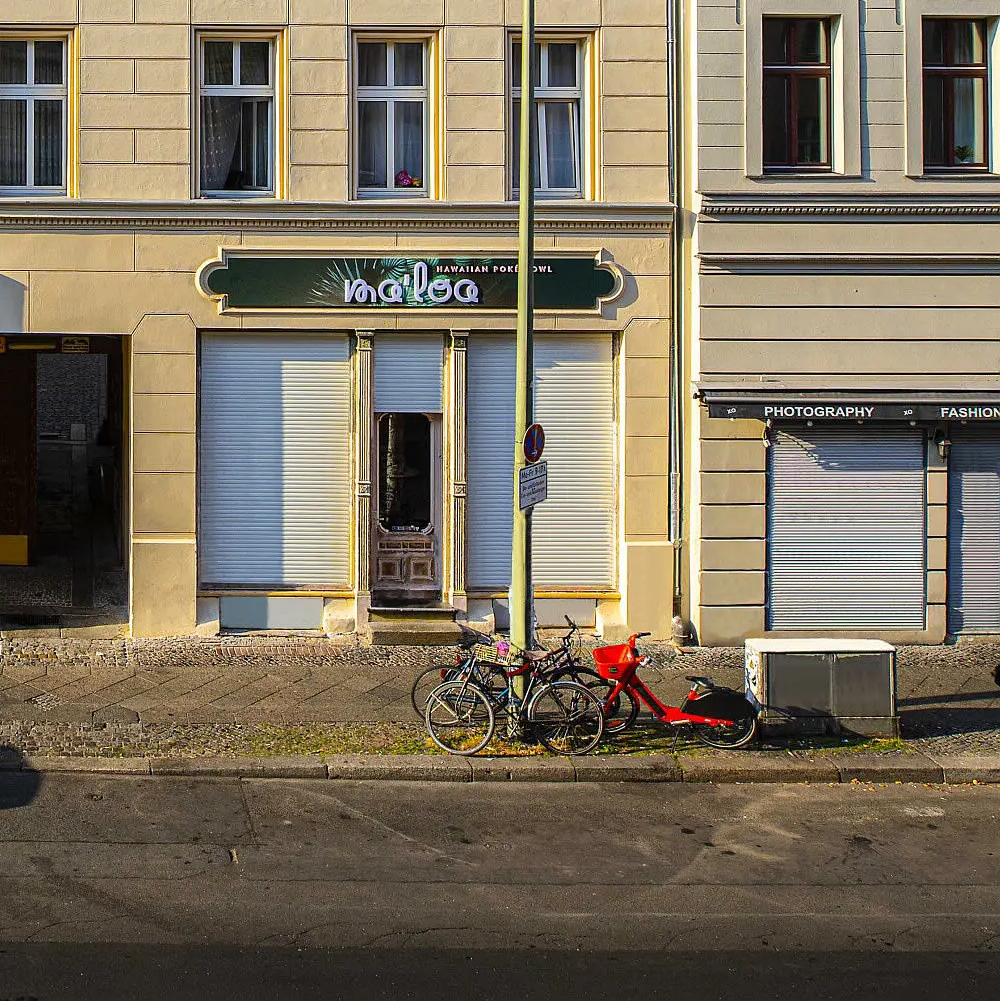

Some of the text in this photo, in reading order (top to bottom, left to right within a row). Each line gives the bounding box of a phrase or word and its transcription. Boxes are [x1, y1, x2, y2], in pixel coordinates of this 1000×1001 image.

[436, 265, 489, 273] HAWAIIAN
[532, 265, 553, 273] OWL
[764, 406, 874, 418] PHOTOGRAPHY
